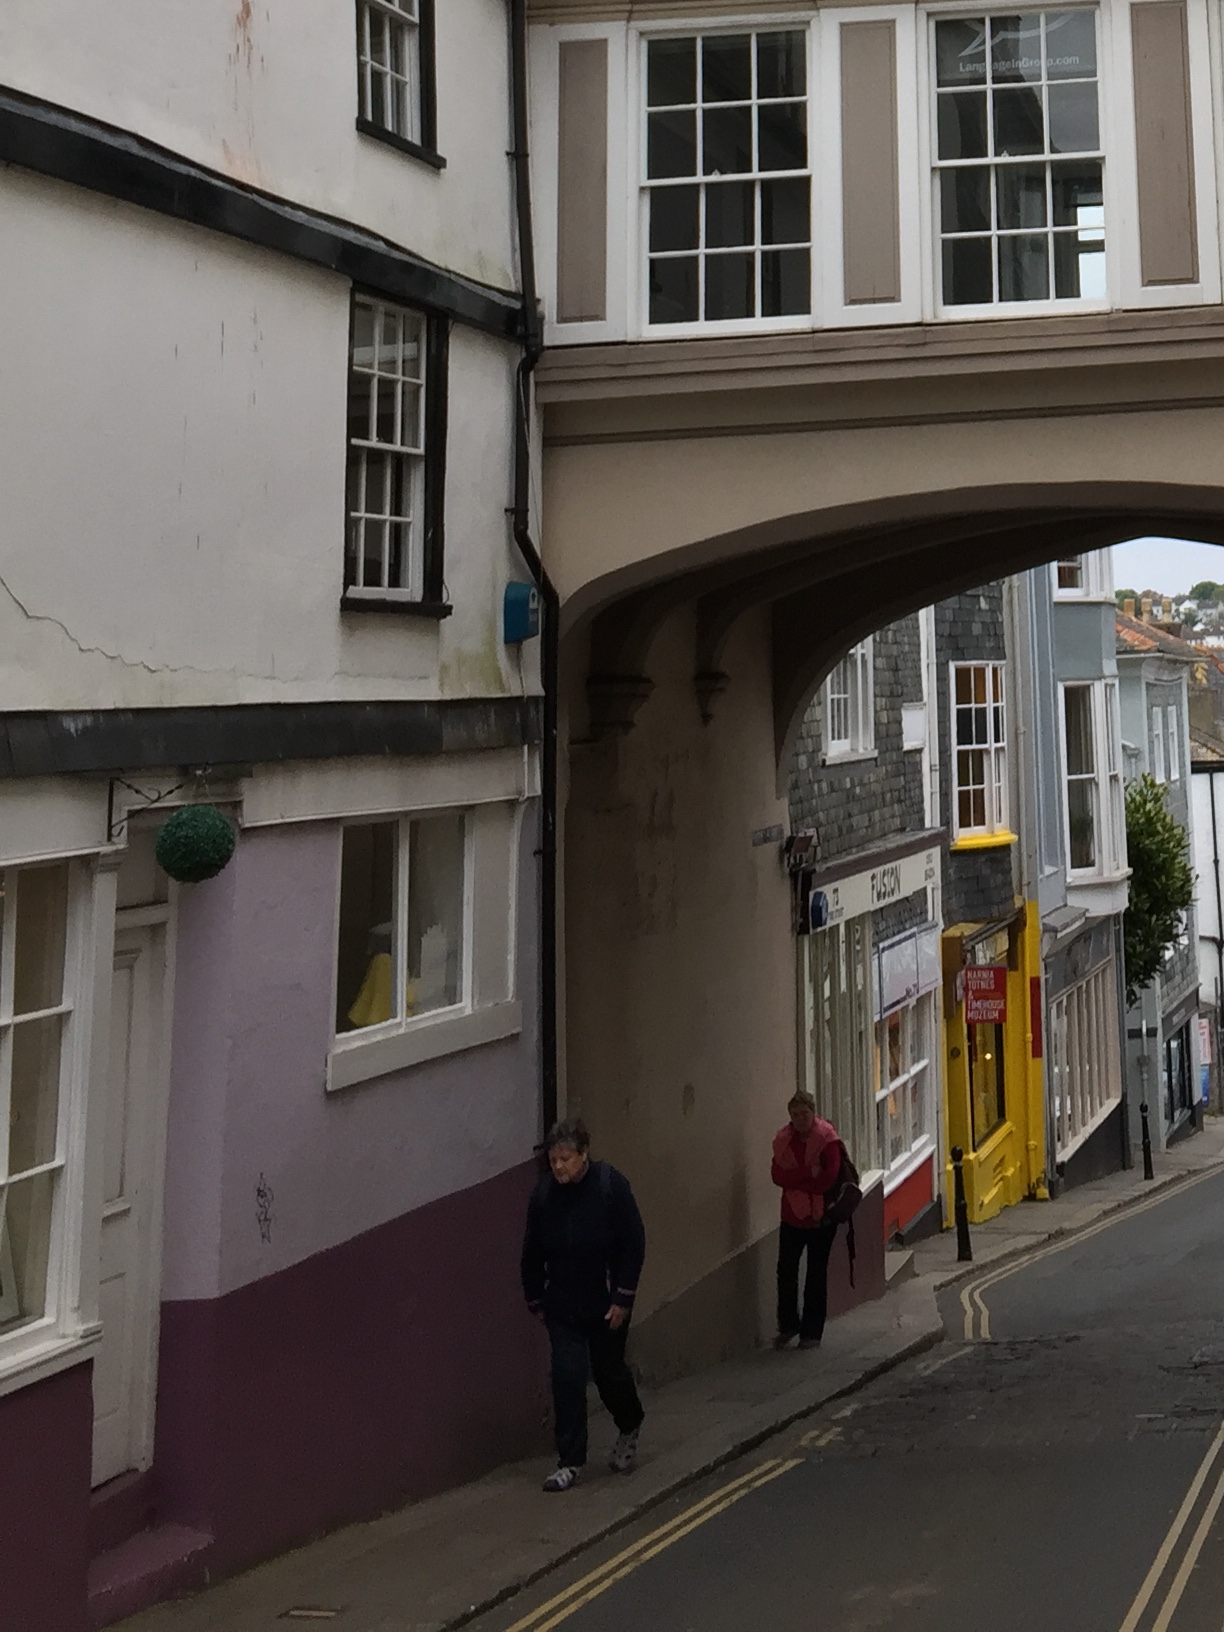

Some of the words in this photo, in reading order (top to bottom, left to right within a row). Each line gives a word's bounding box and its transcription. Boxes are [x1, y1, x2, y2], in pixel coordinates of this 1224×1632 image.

[959, 55, 1080, 74] LangageInGrop.com
[870, 864, 902, 904] FUSION
[967, 970, 995, 979] NARNIA
[968, 979, 995, 990] TOTNES
[968, 999, 1005, 1009] TIMEHOUSE
